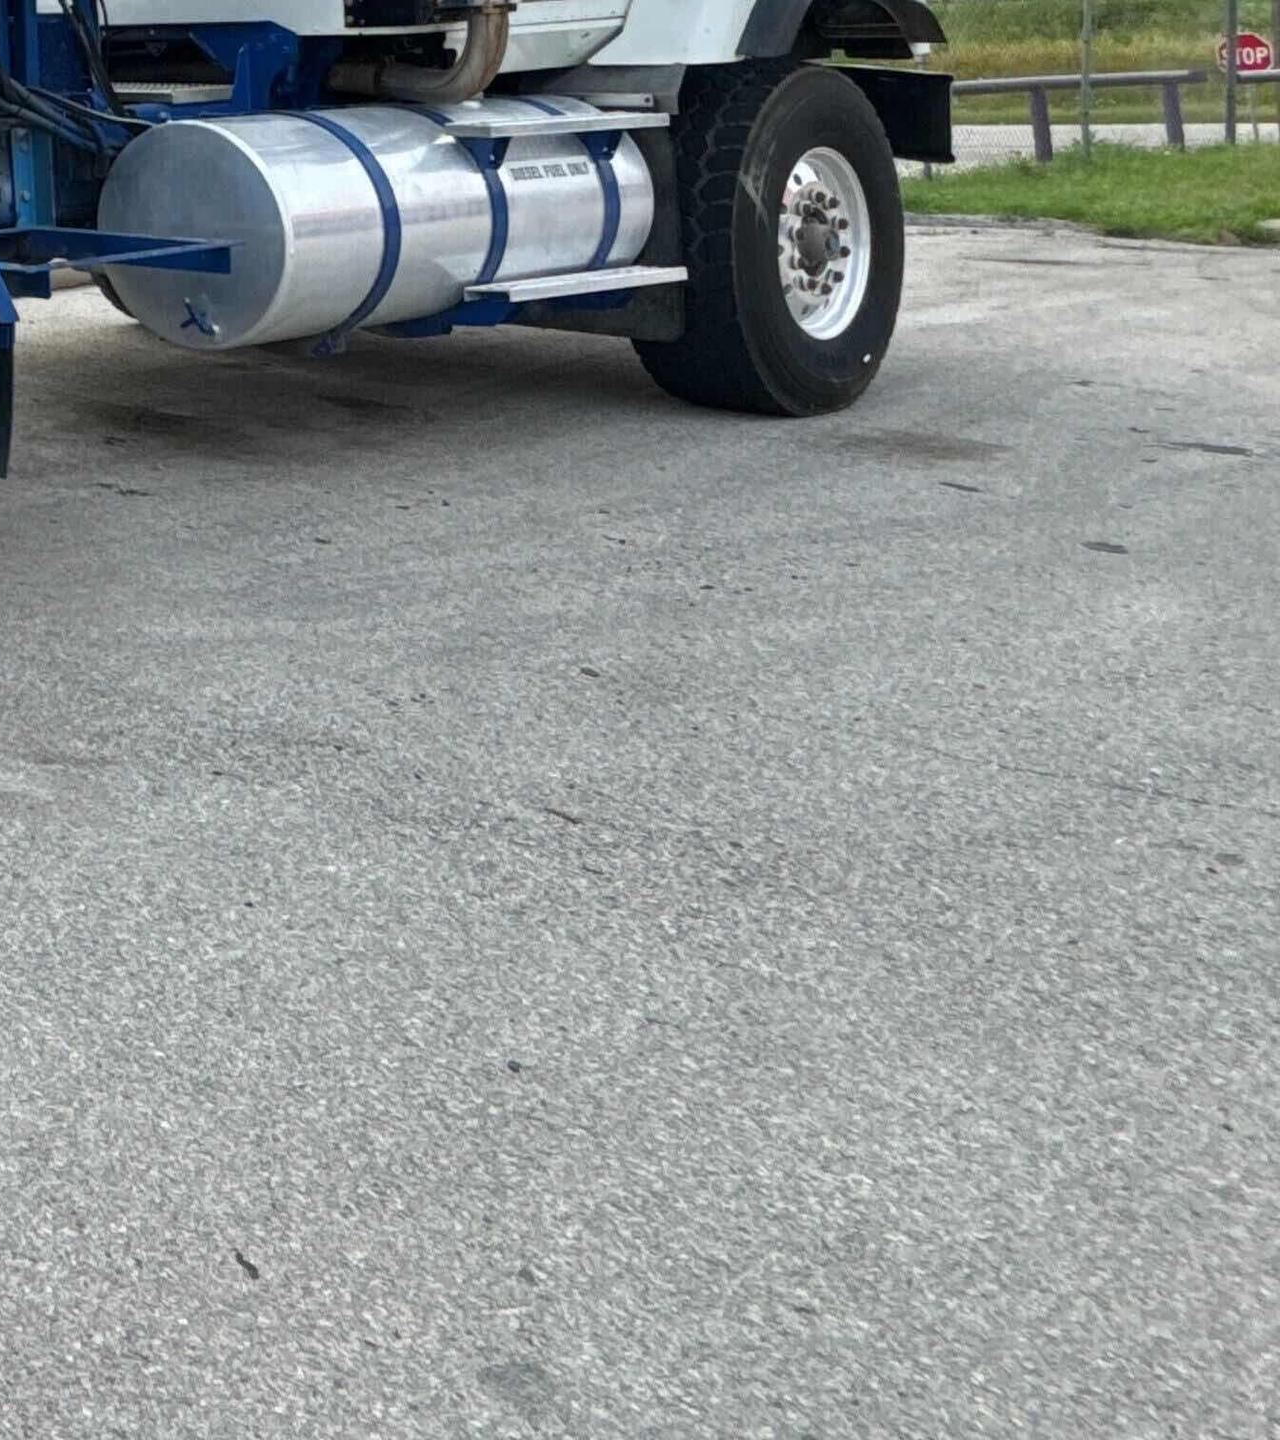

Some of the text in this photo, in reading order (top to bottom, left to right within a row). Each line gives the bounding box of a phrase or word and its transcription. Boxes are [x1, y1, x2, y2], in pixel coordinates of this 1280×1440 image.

[510, 161, 589, 181] DIESEL FUEL ONLY
